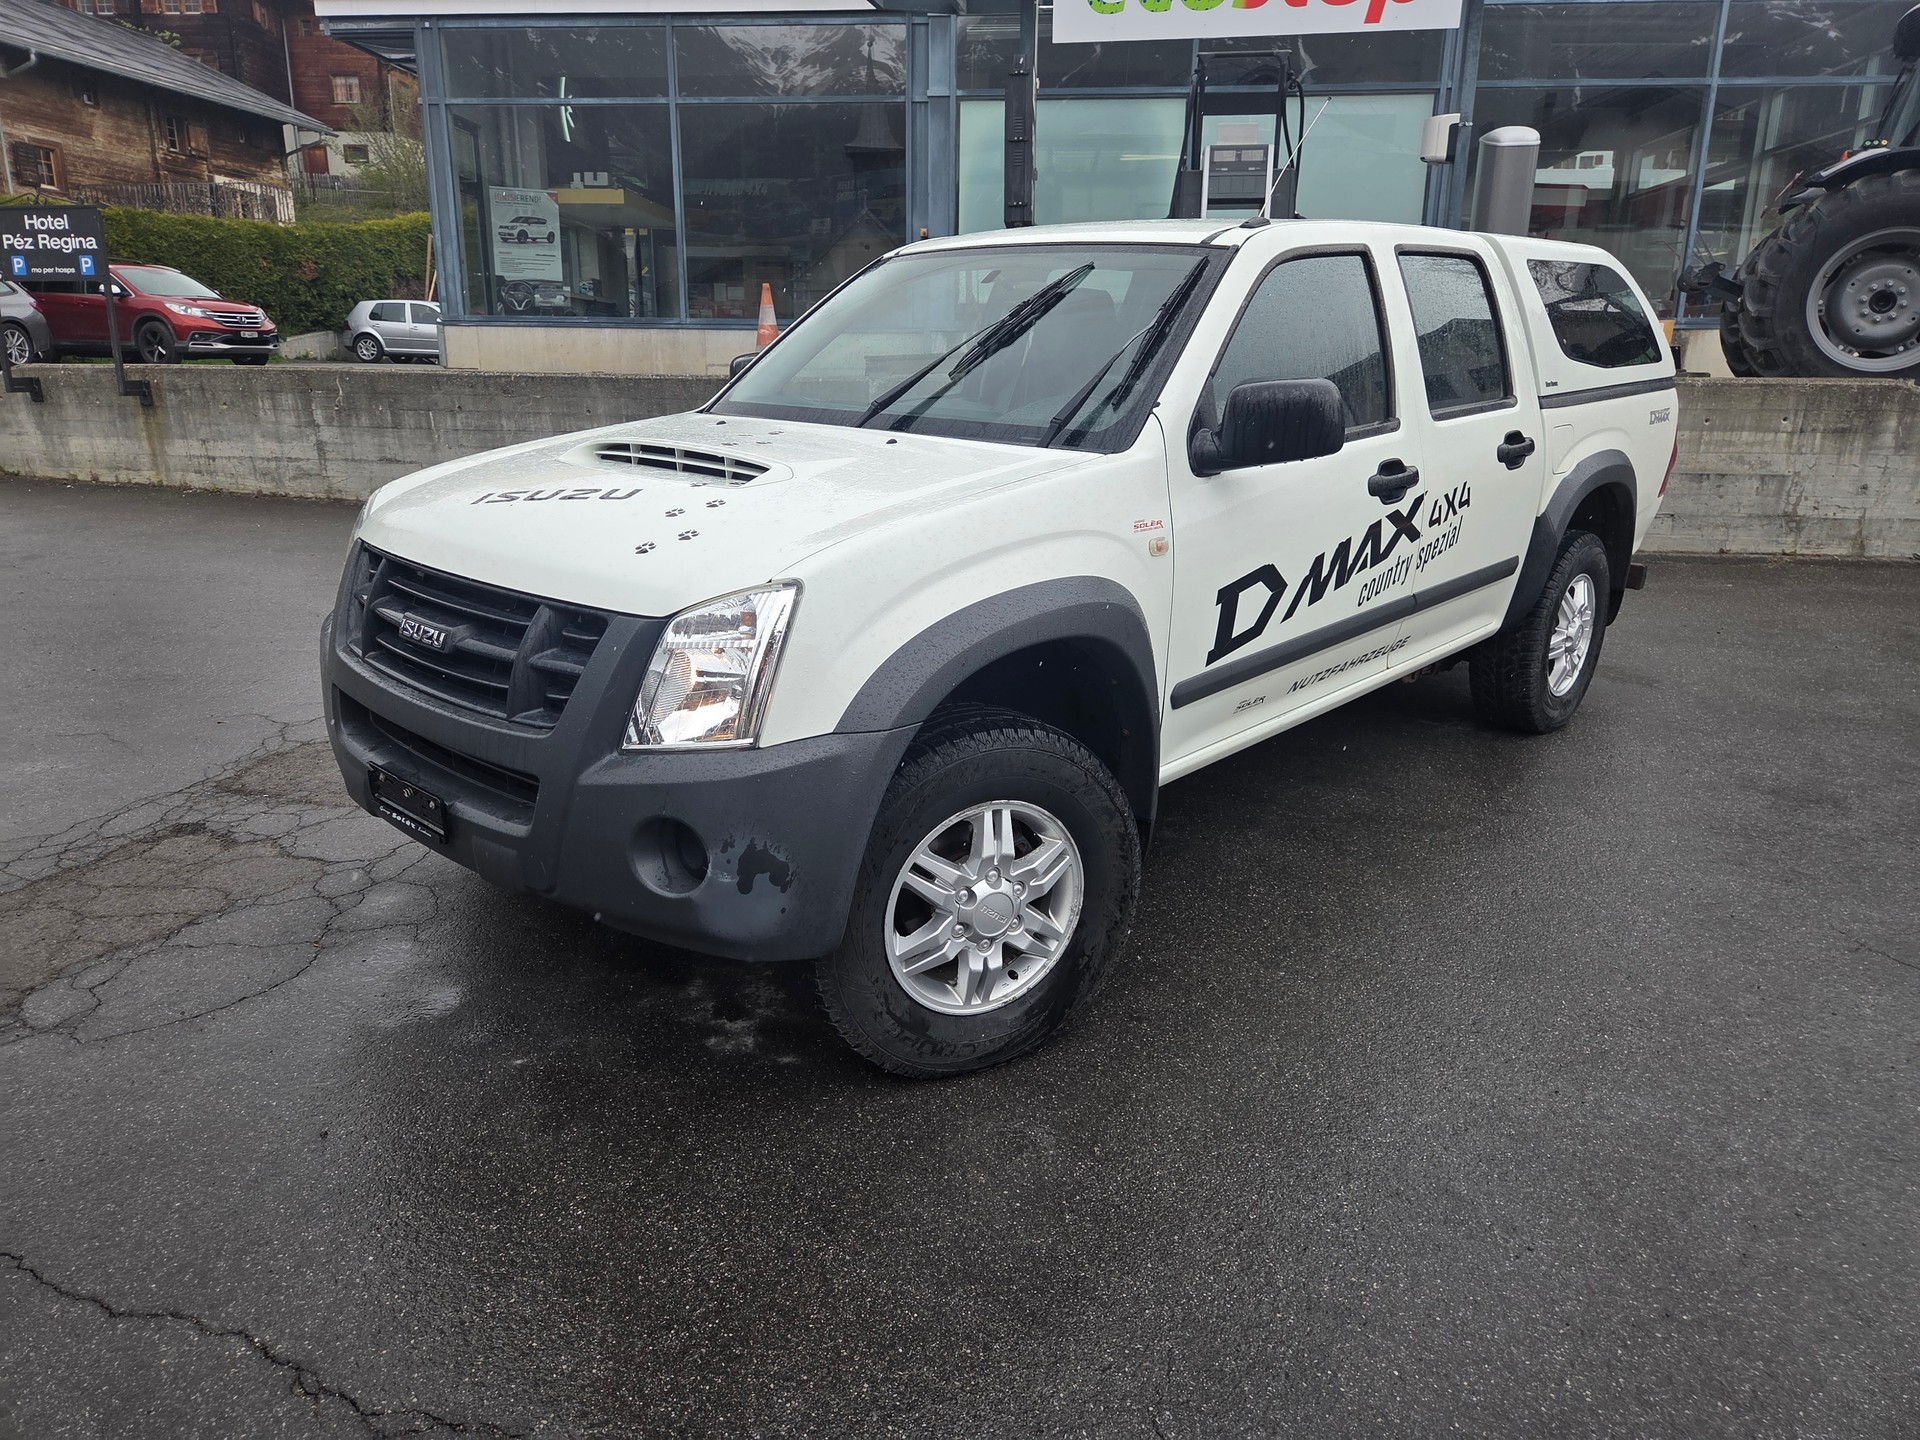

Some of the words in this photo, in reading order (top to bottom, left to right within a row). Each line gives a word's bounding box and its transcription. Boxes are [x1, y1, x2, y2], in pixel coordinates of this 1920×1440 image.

[24, 214, 69, 230] Hotel
[2, 233, 34, 250] Péz
[37, 233, 98, 253] Regina
[13, 257, 23, 273] P
[81, 257, 92, 273] P
[470, 488, 644, 505] ISUZU
[1357, 553, 1412, 608] country
[1415, 515, 1464, 574] spezial
[400, 618, 446, 648] ISUZU
[1286, 635, 1412, 695] NUTZFAHRZEUGE
[980, 905, 1008, 924] ISUZU
